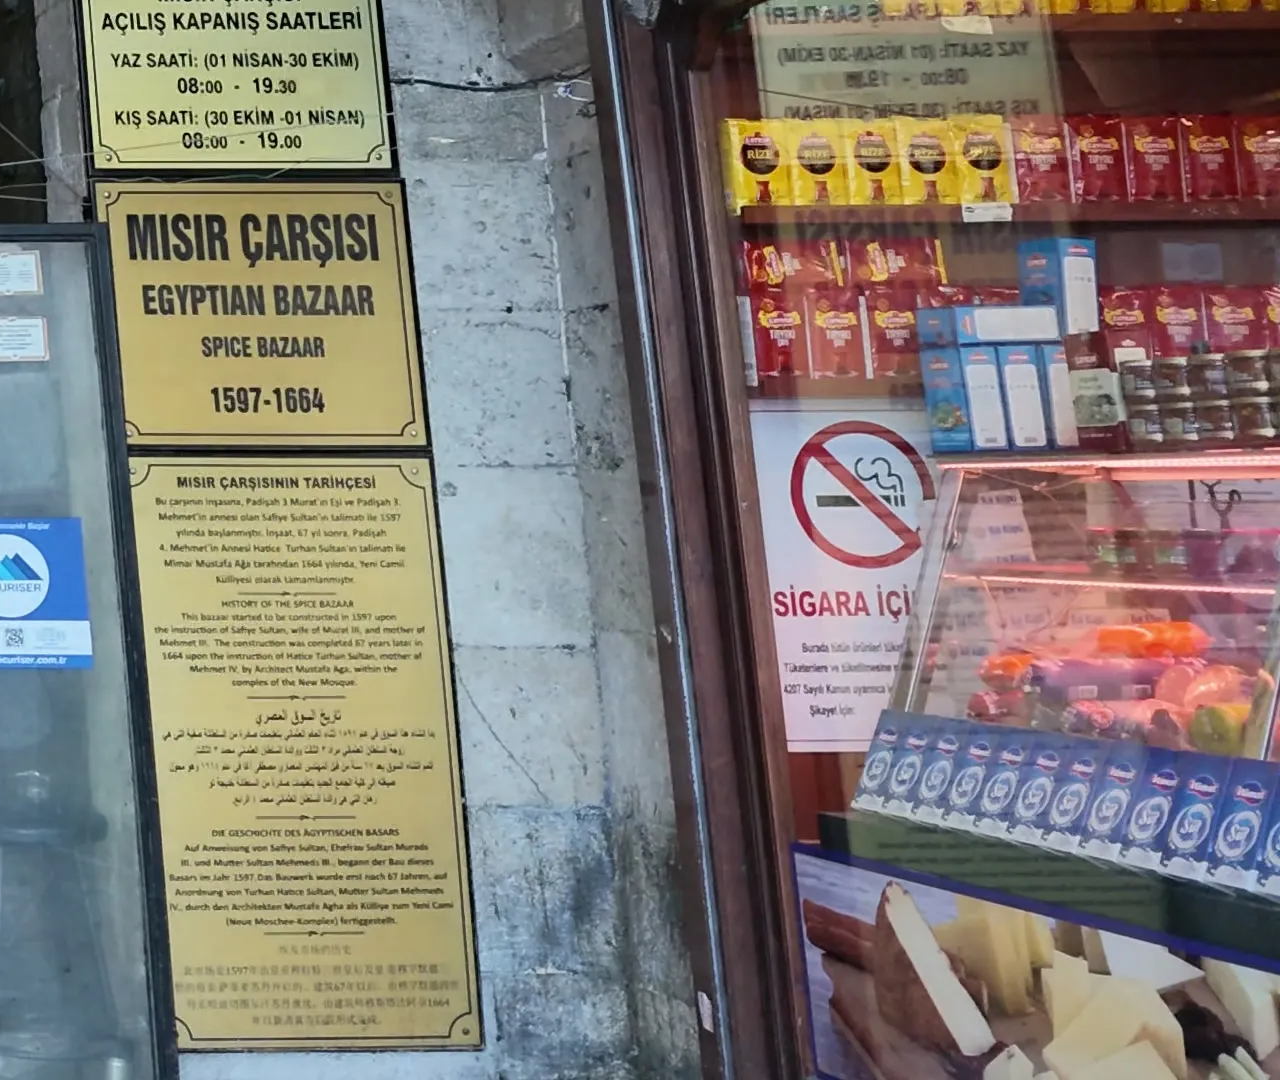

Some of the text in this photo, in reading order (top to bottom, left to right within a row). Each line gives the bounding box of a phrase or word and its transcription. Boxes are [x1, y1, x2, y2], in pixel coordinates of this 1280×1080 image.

[102, 6, 363, 36] AÇILIŞ KAPANIŞ SAATLERİ
[110, 47, 360, 72] YAZ SAATİ: (01 NİSAN-30 EKİM)
[177, 77, 224, 95] 08:00
[252, 77, 298, 95] 19.30
[114, 110, 142, 130] KIŞ
[146, 105, 200, 126] SAATİ:
[204, 110, 230, 128] (30
[233, 106, 274, 126] EKİM
[308, 105, 366, 128] NİSAN)
[181, 132, 228, 150] 08:00
[257, 132, 303, 150] 19.00
[127, 213, 380, 268] MISIR ÇARŞISI
[142, 284, 376, 317] EGYPTIAN BAZAAR
[201, 336, 326, 358] SPICE BAZAAR
[210, 387, 326, 414] 1597-1664
[176, 476, 376, 491] MISIR ÇARŞISININ TARİHÇESİ
[773, 584, 871, 618] SİGARA
